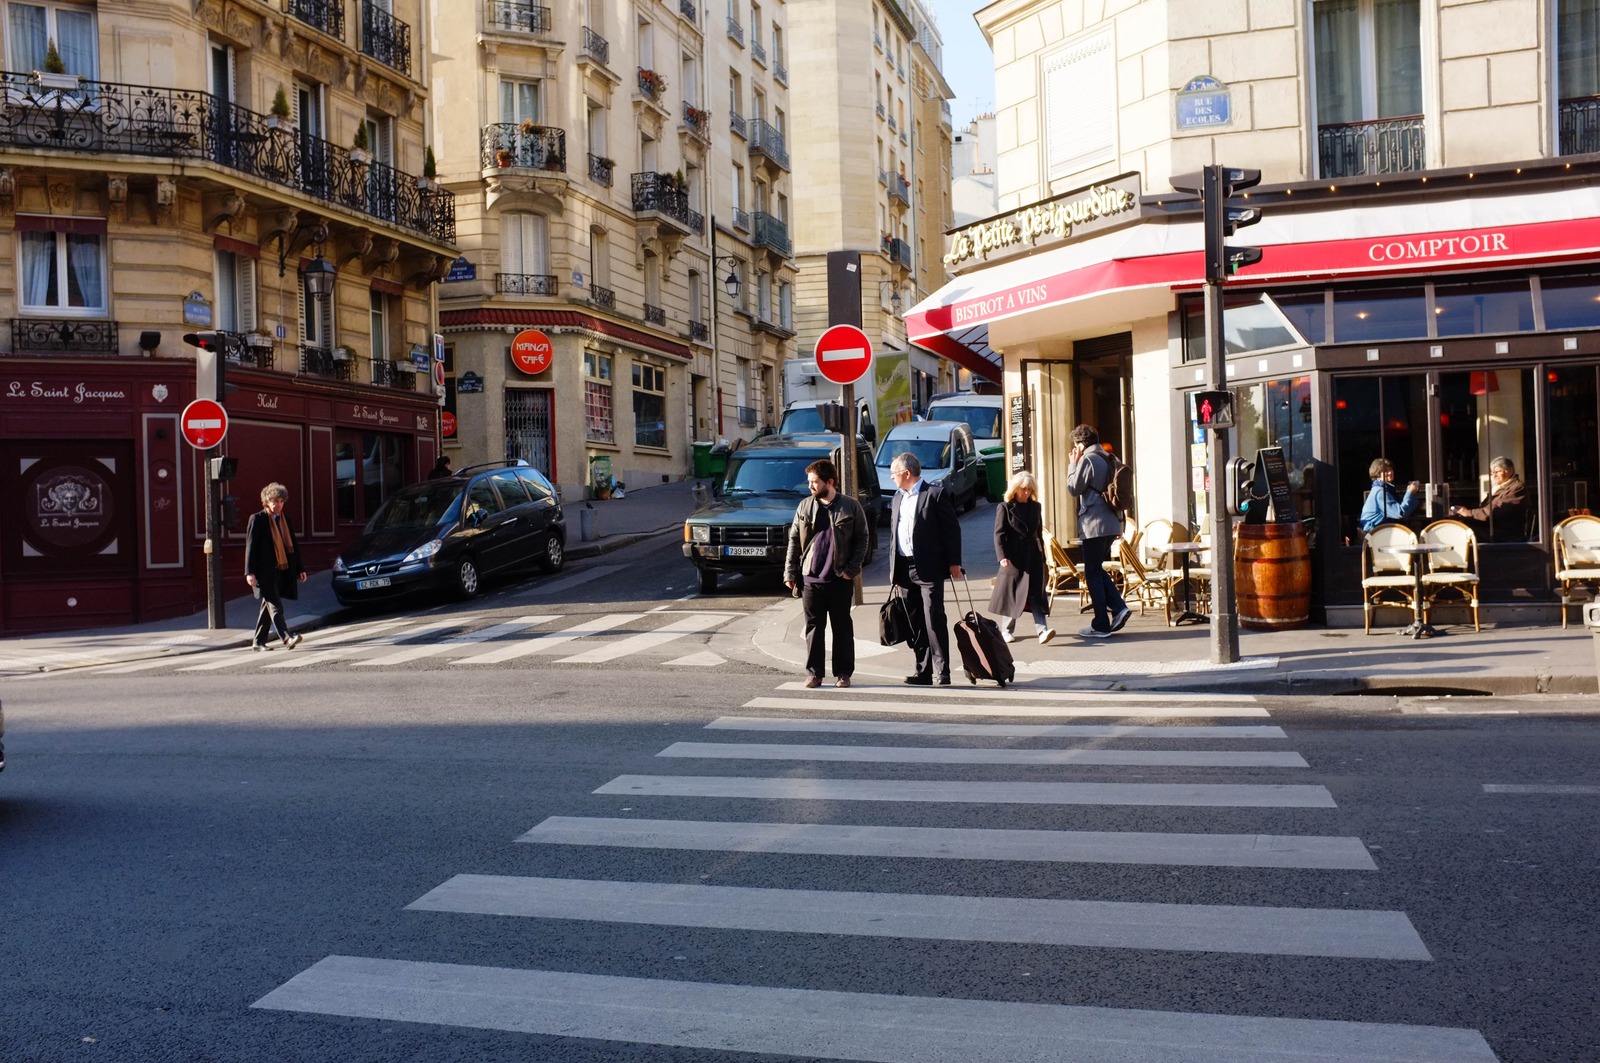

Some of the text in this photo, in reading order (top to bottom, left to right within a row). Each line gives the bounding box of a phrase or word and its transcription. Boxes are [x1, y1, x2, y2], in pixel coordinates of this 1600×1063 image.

[1194, 97, 1212, 106] RUE
[1195, 106, 1212, 115] DES
[1186, 114, 1221, 125] ECOLES
[943, 231, 968, 268] La
[968, 219, 1014, 259] Petite
[1368, 232, 1509, 262] COMPTOIR
[955, 284, 1047, 323] BISTROT A VINS
[516, 342, 549, 352] MANGA
[521, 353, 545, 365] CAFÉ
[6, 381, 126, 404] Le Saint Jacques
[352, 405, 399, 425] Le Saint Jacques
